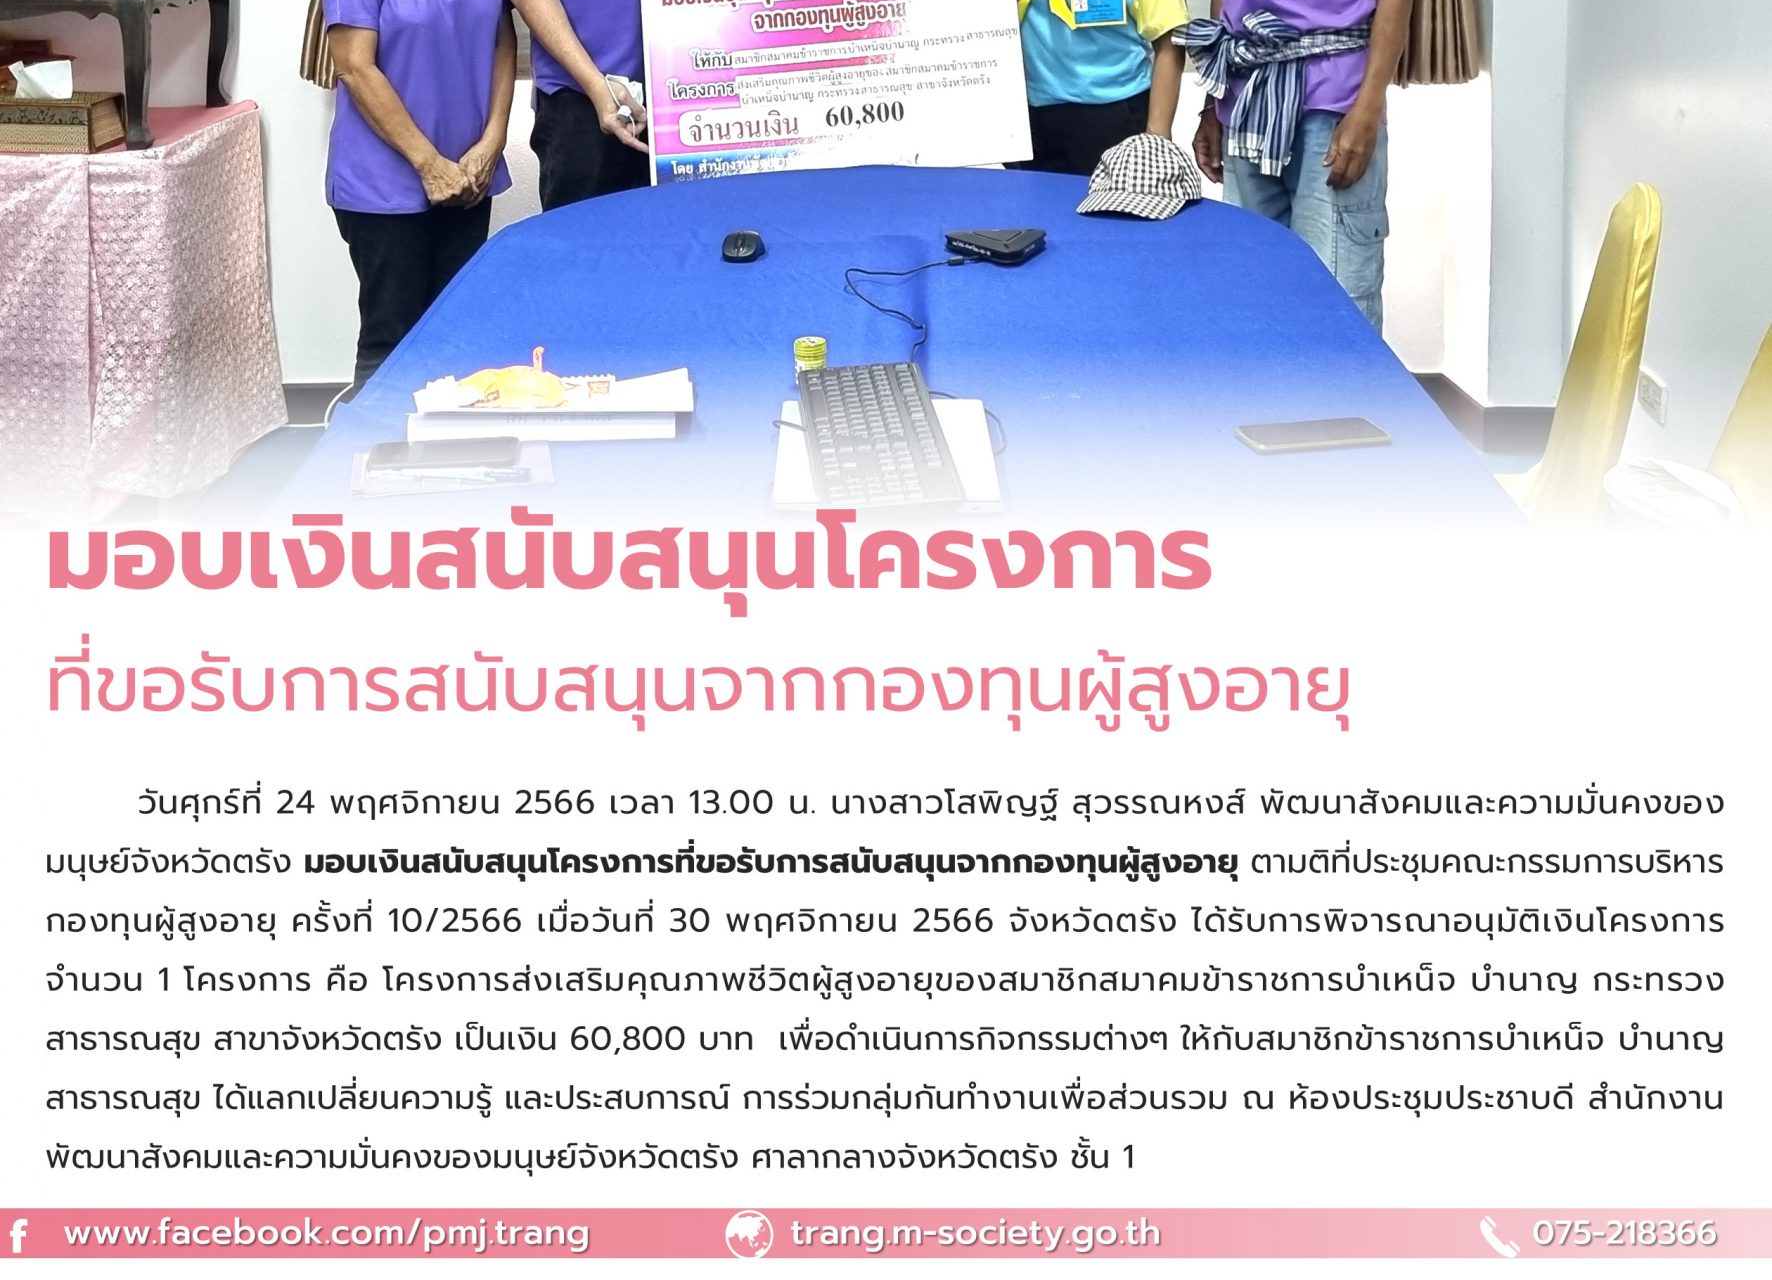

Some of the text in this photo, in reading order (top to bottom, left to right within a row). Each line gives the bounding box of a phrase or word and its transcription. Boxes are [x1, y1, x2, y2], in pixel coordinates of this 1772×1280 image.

[667, 79, 736, 99] โครงการ
[688, 100, 905, 143] จำนวนเงิน 60,800
